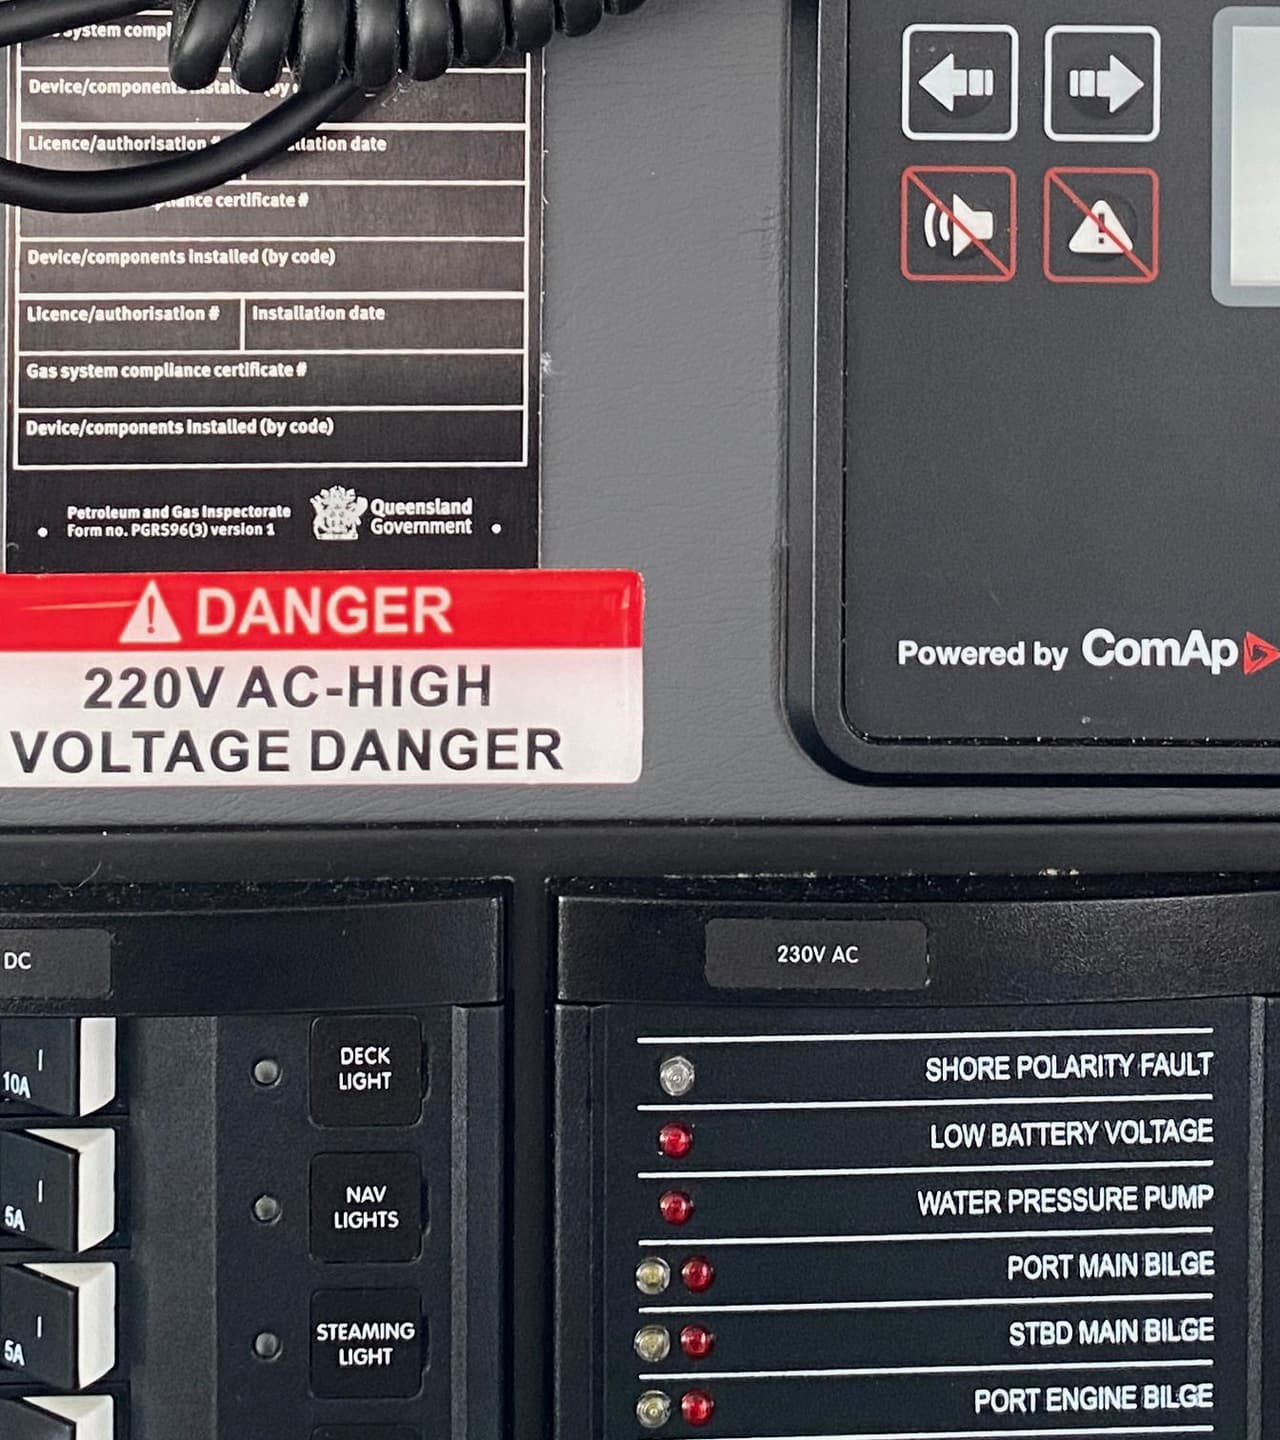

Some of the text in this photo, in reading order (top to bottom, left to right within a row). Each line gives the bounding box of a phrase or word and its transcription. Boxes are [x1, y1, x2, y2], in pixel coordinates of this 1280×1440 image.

[27, 248, 186, 268] Device/components
[261, 247, 289, 268] (by
[291, 247, 336, 267] code)
[27, 304, 206, 324] Licence/authorisation
[252, 304, 386, 321] Installation date
[26, 361, 294, 383] Gas system compliance certificate
[67, 504, 292, 522] Petroleum and Gas Inspectorate
[370, 497, 473, 518] Queensland
[67, 521, 276, 539] Form no. PGR596(3) version 1
[370, 517, 473, 535] Government
[197, 585, 453, 635] DANGER
[898, 628, 1239, 675] Powered by ComAp
[83, 664, 491, 709] 220V AC-HIGH
[10, 727, 564, 774] VOLTAGE DANGER
[777, 944, 859, 964] 230V AC
[340, 1046, 391, 1066] DECK
[925, 1051, 1215, 1083] SHORE POLARITY FAULT
[2, 1071, 31, 1099] 10A
[338, 1071, 392, 1091] LIGHT
[930, 1117, 1214, 1149] LOW BATTERY VOLTAGE
[346, 1185, 387, 1204] NAV
[334, 1210, 399, 1229] LIGHTS
[1007, 1250, 1216, 1281] PORT MAIN BILGE
